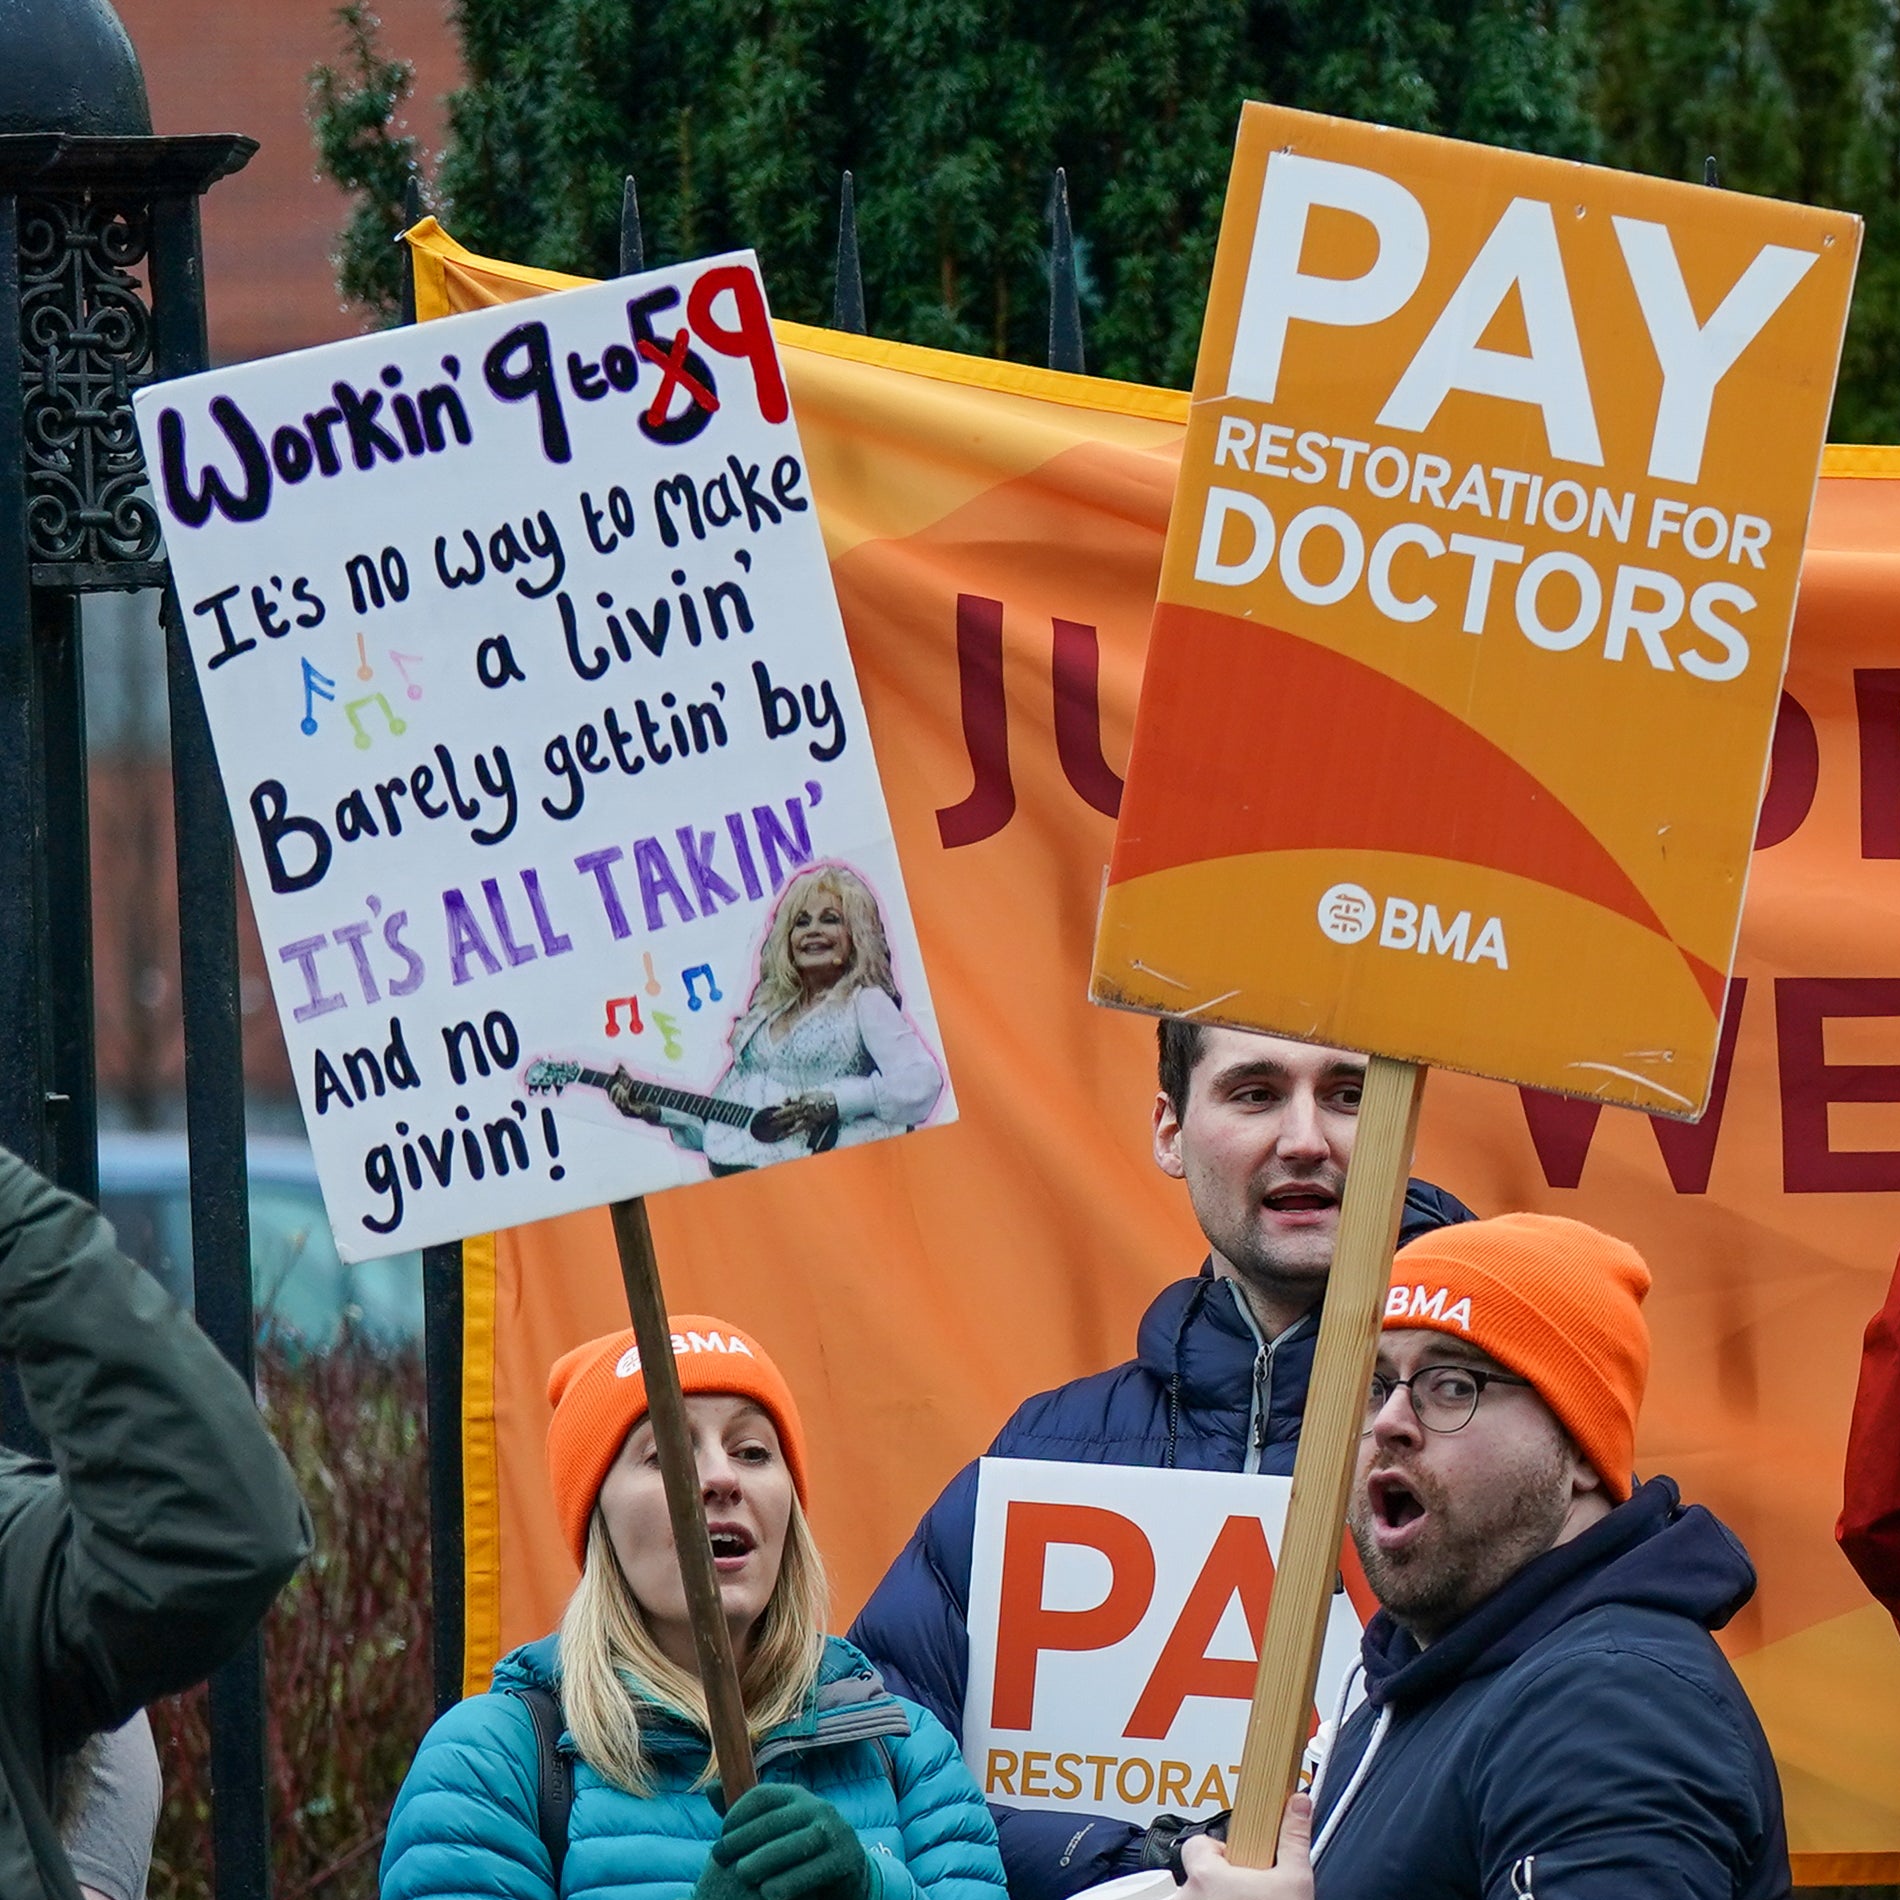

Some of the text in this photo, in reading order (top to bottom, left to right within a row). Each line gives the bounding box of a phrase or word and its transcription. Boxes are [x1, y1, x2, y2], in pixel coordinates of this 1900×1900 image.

[1226, 150, 1819, 486] PAY
[155, 355, 474, 528] Workin'
[482, 320, 573, 465] 9
[569, 340, 642, 400] to
[1213, 416, 1773, 571] RESTORATION FOR
[192, 569, 326, 671] It's
[346, 546, 409, 612] no
[432, 505, 563, 600] way
[579, 490, 637, 555] to
[476, 631, 525, 690] a
[1194, 486, 1758, 685] DOCTORS
[248, 660, 849, 894] Barely gettin' by
[279, 780, 825, 1025] IT'S ALL TAKIN'
[1378, 895, 1509, 971] BMA
[313, 1008, 521, 1116] And no
[1384, 1284, 1472, 1332] BMA
[985, 1748, 1251, 1812] RESTORA
